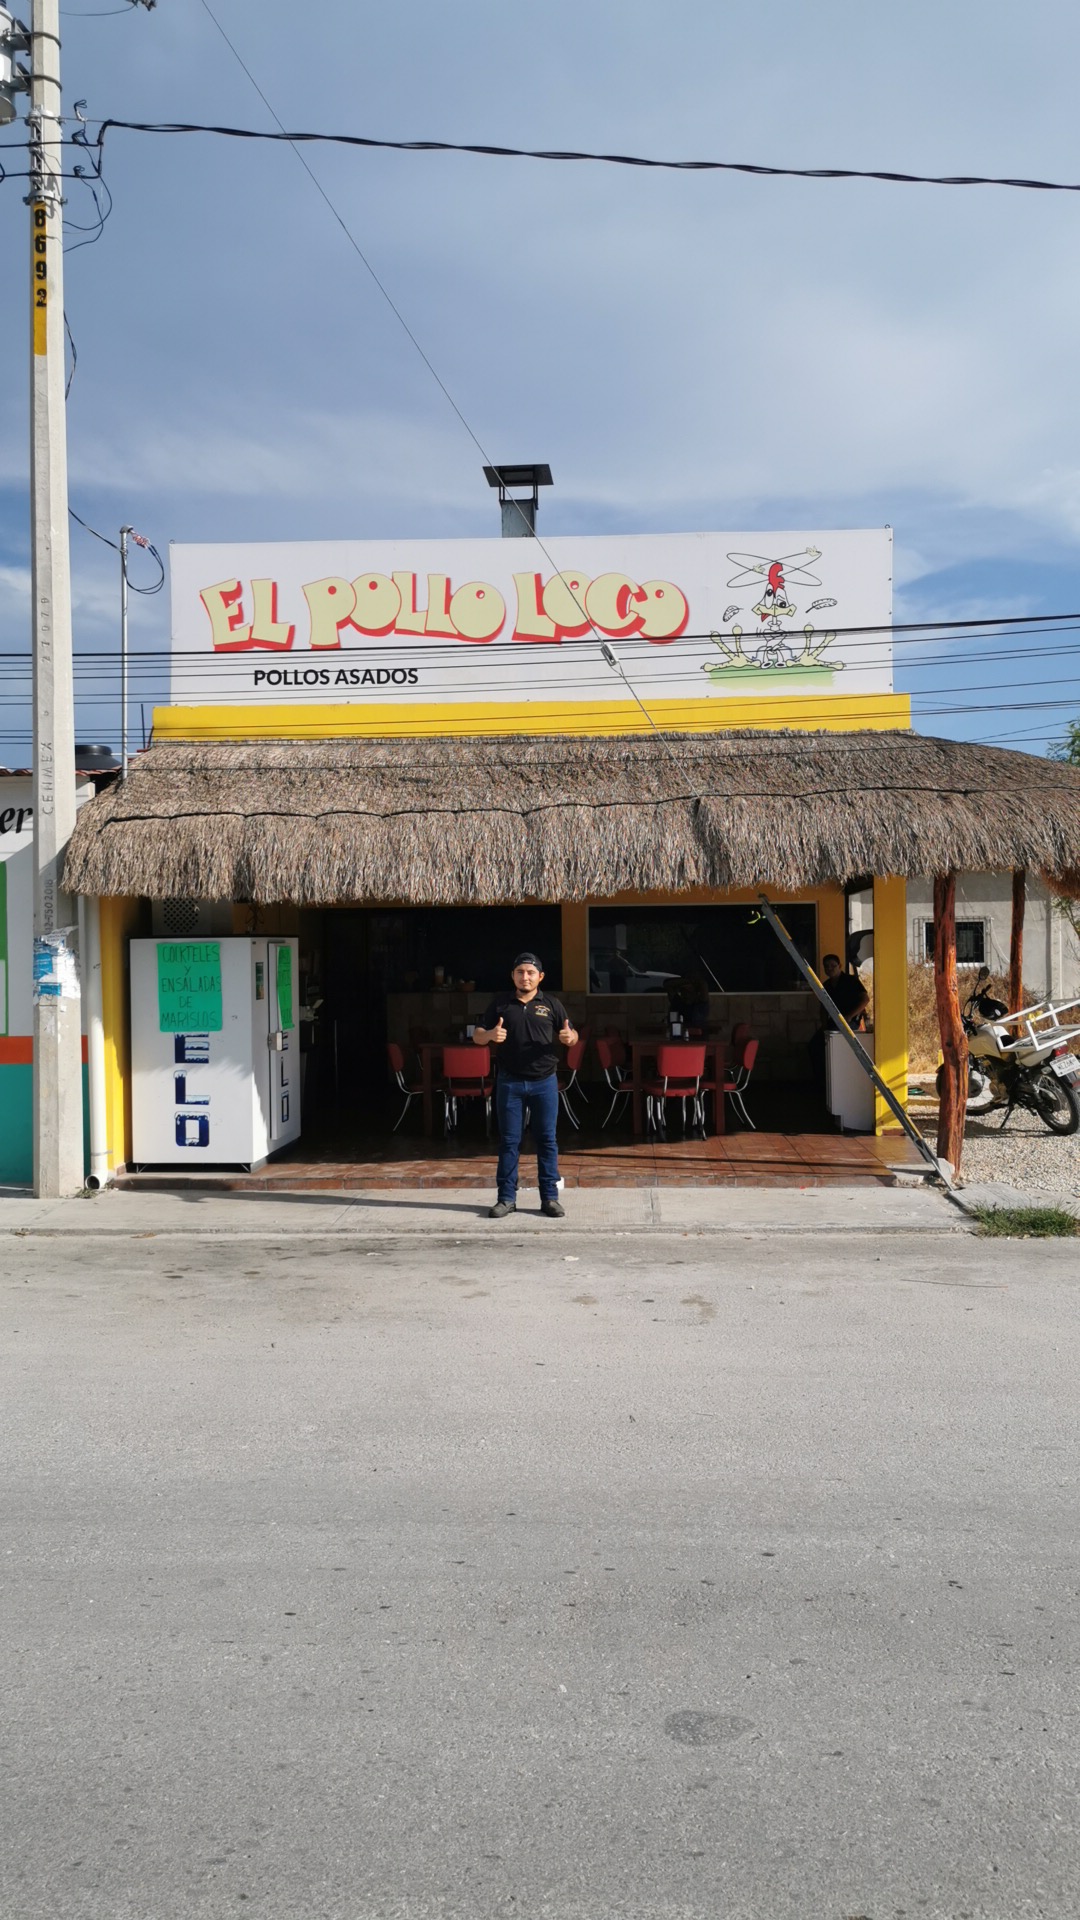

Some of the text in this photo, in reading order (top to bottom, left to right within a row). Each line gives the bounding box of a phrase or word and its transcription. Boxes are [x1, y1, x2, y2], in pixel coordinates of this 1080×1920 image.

[35, 209, 47, 307] 8692
[200, 570, 689, 652] EL POLLO LOCO
[254, 668, 418, 685] POLLOS ASADOS
[161, 976, 222, 993] ENSALADAS
[179, 996, 192, 1008] DE
